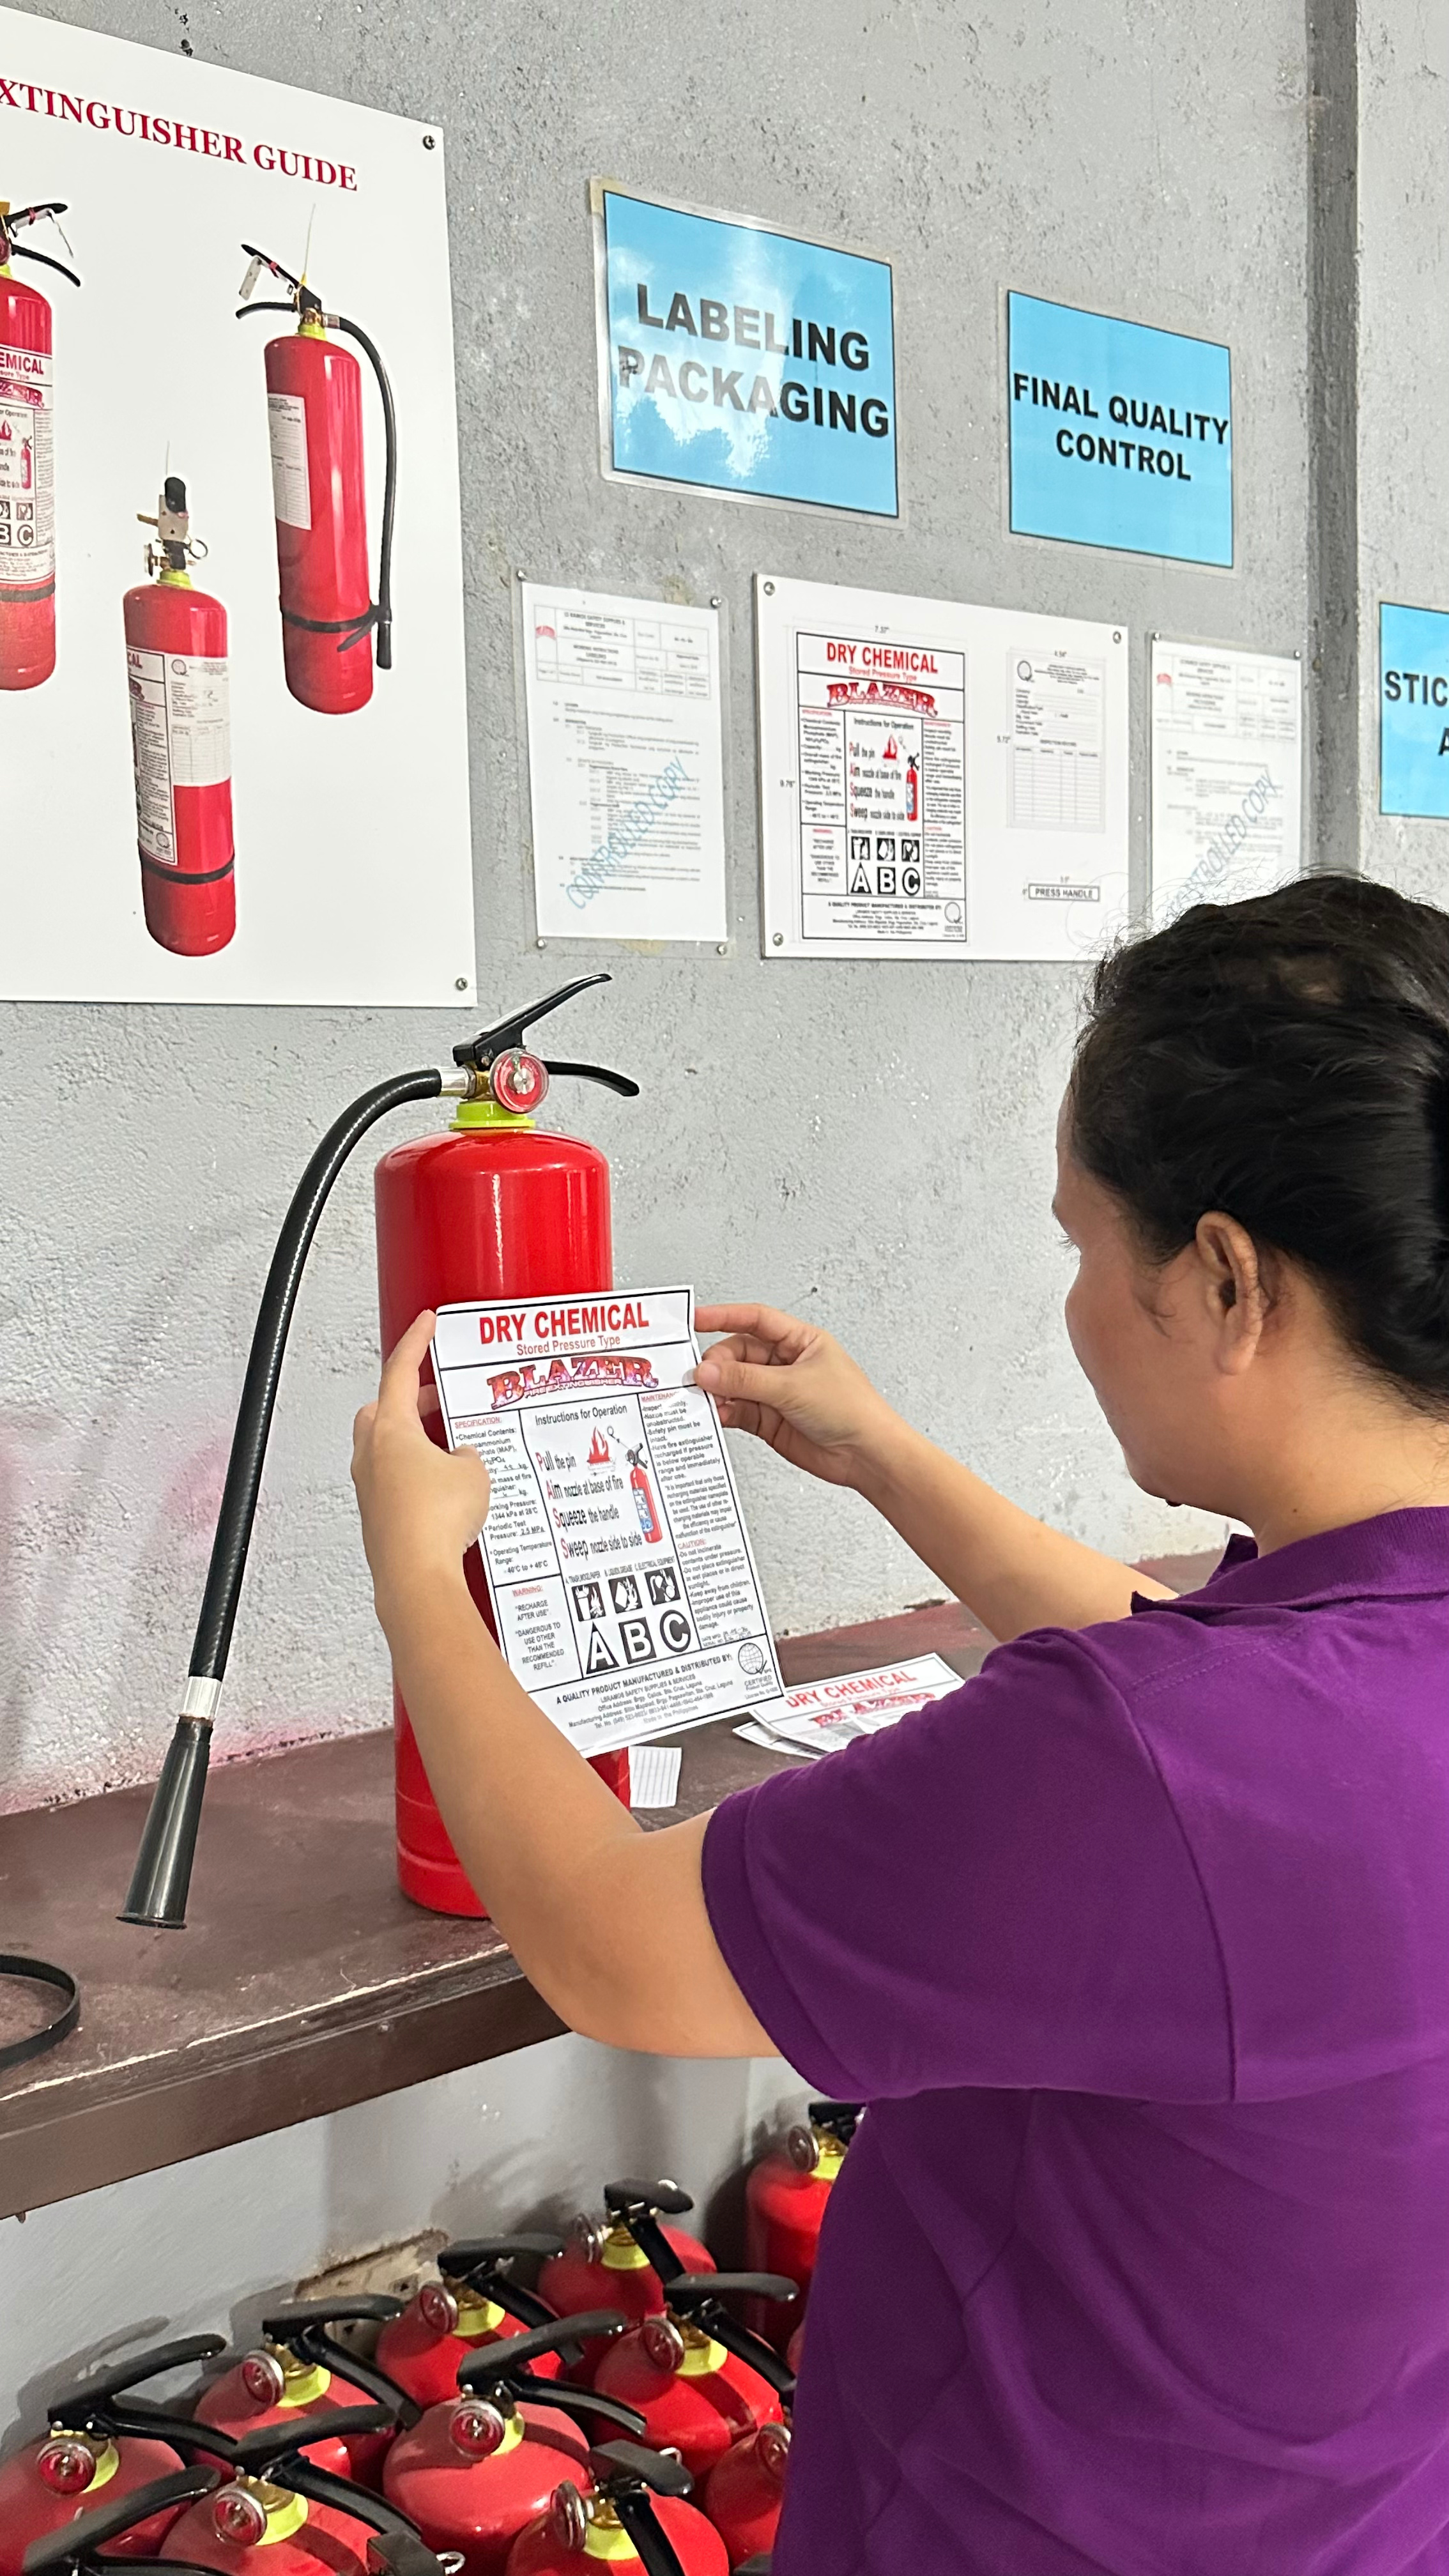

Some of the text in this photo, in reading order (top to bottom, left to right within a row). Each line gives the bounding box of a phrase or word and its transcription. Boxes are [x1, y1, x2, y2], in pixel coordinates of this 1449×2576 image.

[0, 78, 358, 190] XTINGUISHER GUIDE
[637, 282, 870, 371] LABELING
[0, 353, 44, 375] EMICAL
[618, 345, 889, 438] PACKAGING
[1013, 372, 1229, 445] FINAL QUALITY
[1055, 429, 1192, 482] CONTROL
[827, 642, 938, 674] DRY CHEMICAL
[848, 666, 917, 683] Stored Pressure Type
[1384, 670, 1449, 708] STIC
[827, 681, 938, 718] BLAZER
[849, 741, 859, 757] Pull
[850, 781, 872, 800] Squeeze
[1241, 768, 1278, 824] COPY
[850, 802, 868, 821] Sweep
[566, 800, 654, 910] CONTROLLED
[648, 755, 689, 810] COPY
[852, 866, 919, 894] A B C
[1035, 887, 1092, 899] PRESS HANDLE
[479, 1302, 650, 1344] DRY CHEMICAL
[516, 1335, 621, 1356] Stored Pressure Type
[486, 1355, 659, 1411] BLAZER
[524, 1377, 624, 1399] FIRE EXTINGUISHER
[535, 1404, 628, 1426] Instructions for Operation
[458, 1428, 516, 1441] Chemical Contents:
[667, 1425, 677, 1434] pin
[677, 1422, 693, 1430] must
[678, 1435, 713, 1446] extinguisher
[688, 1443, 714, 1453] pressure
[535, 1450, 577, 1472] Pull the pin
[675, 1463, 687, 1471] and
[686, 1457, 721, 1469] immediately
[680, 1453, 705, 1463] operable
[546, 1475, 624, 1499] Aim nozzle at base of fire
[509, 1499, 537, 1508] Pressure:
[491, 1512, 505, 1521] 1344
[553, 1504, 620, 1531] Squeeze the handle
[487, 1522, 513, 1531] Periodic
[489, 1527, 530, 1541] Pressure: 2.5
[493, 1541, 553, 1557] Operating Temperature
[560, 1531, 643, 1561] Sweep nozzle side to side
[677, 1538, 707, 1550] CAUTION:
[696, 1544, 722, 1554] incinerate
[494, 1557, 513, 1565] Range:
[701, 1562, 716, 1571] place
[716, 1556, 745, 1567] extinguisher
[730, 1563, 745, 1572] direct
[517, 1611, 535, 1621] AFTER
[711, 1611, 726, 1619] injury
[733, 1604, 753, 1615] property
[524, 1632, 556, 1645] USE OTHER
[527, 1641, 555, 1653] THAN THE
[585, 1634, 614, 1670] A
[622, 1621, 651, 1660] B
[663, 1613, 689, 1648] C
[521, 1648, 565, 1664] RECOMMENDED
[556, 1653, 732, 1705] A QUALITY PRODUCT MANUFACTURED & DISTRIBUTED BY:
[744, 1675, 772, 1687] CERTIFIED
[824, 1671, 917, 1698] CHEMICAL
